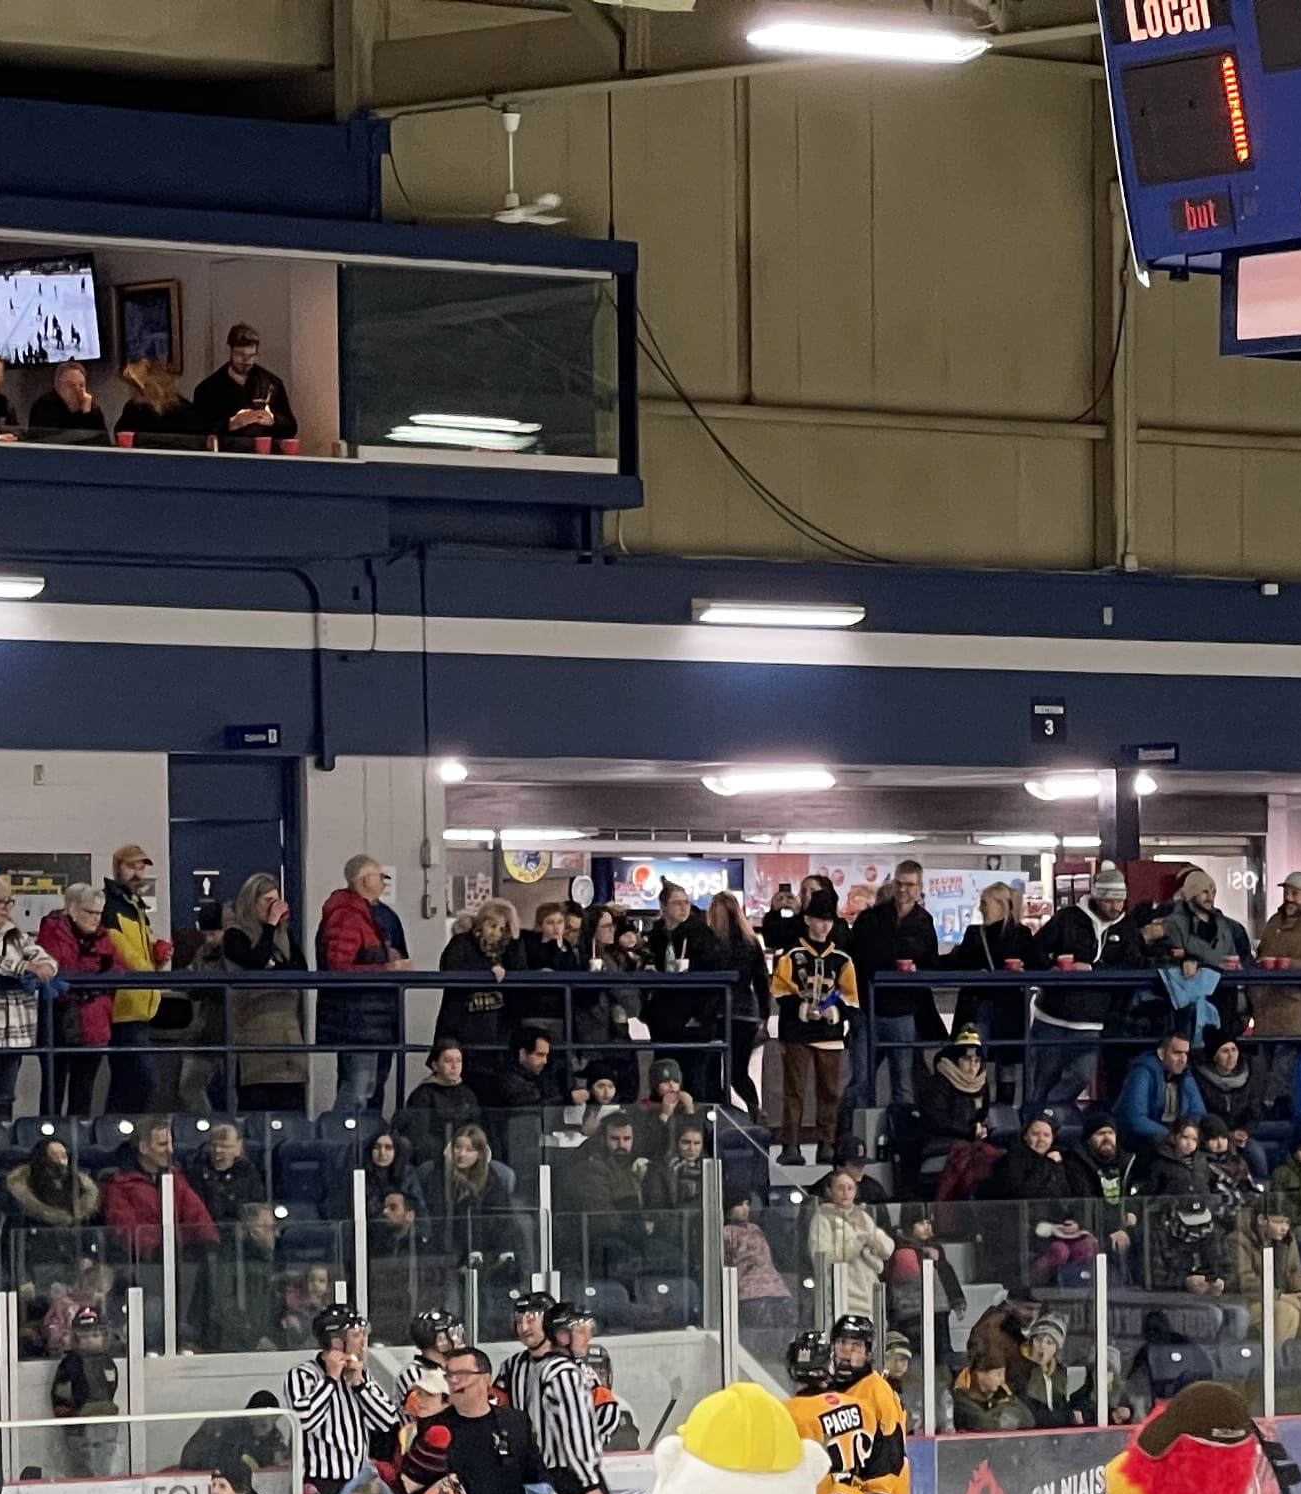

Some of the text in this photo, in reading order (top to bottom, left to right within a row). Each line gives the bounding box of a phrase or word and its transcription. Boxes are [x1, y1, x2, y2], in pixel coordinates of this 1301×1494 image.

[1125, 0, 1212, 41] Local
[1222, 55, 1250, 163] 1
[1184, 198, 1218, 231] but
[1044, 719, 1055, 736] 3
[822, 1407, 862, 1436] PARIS
